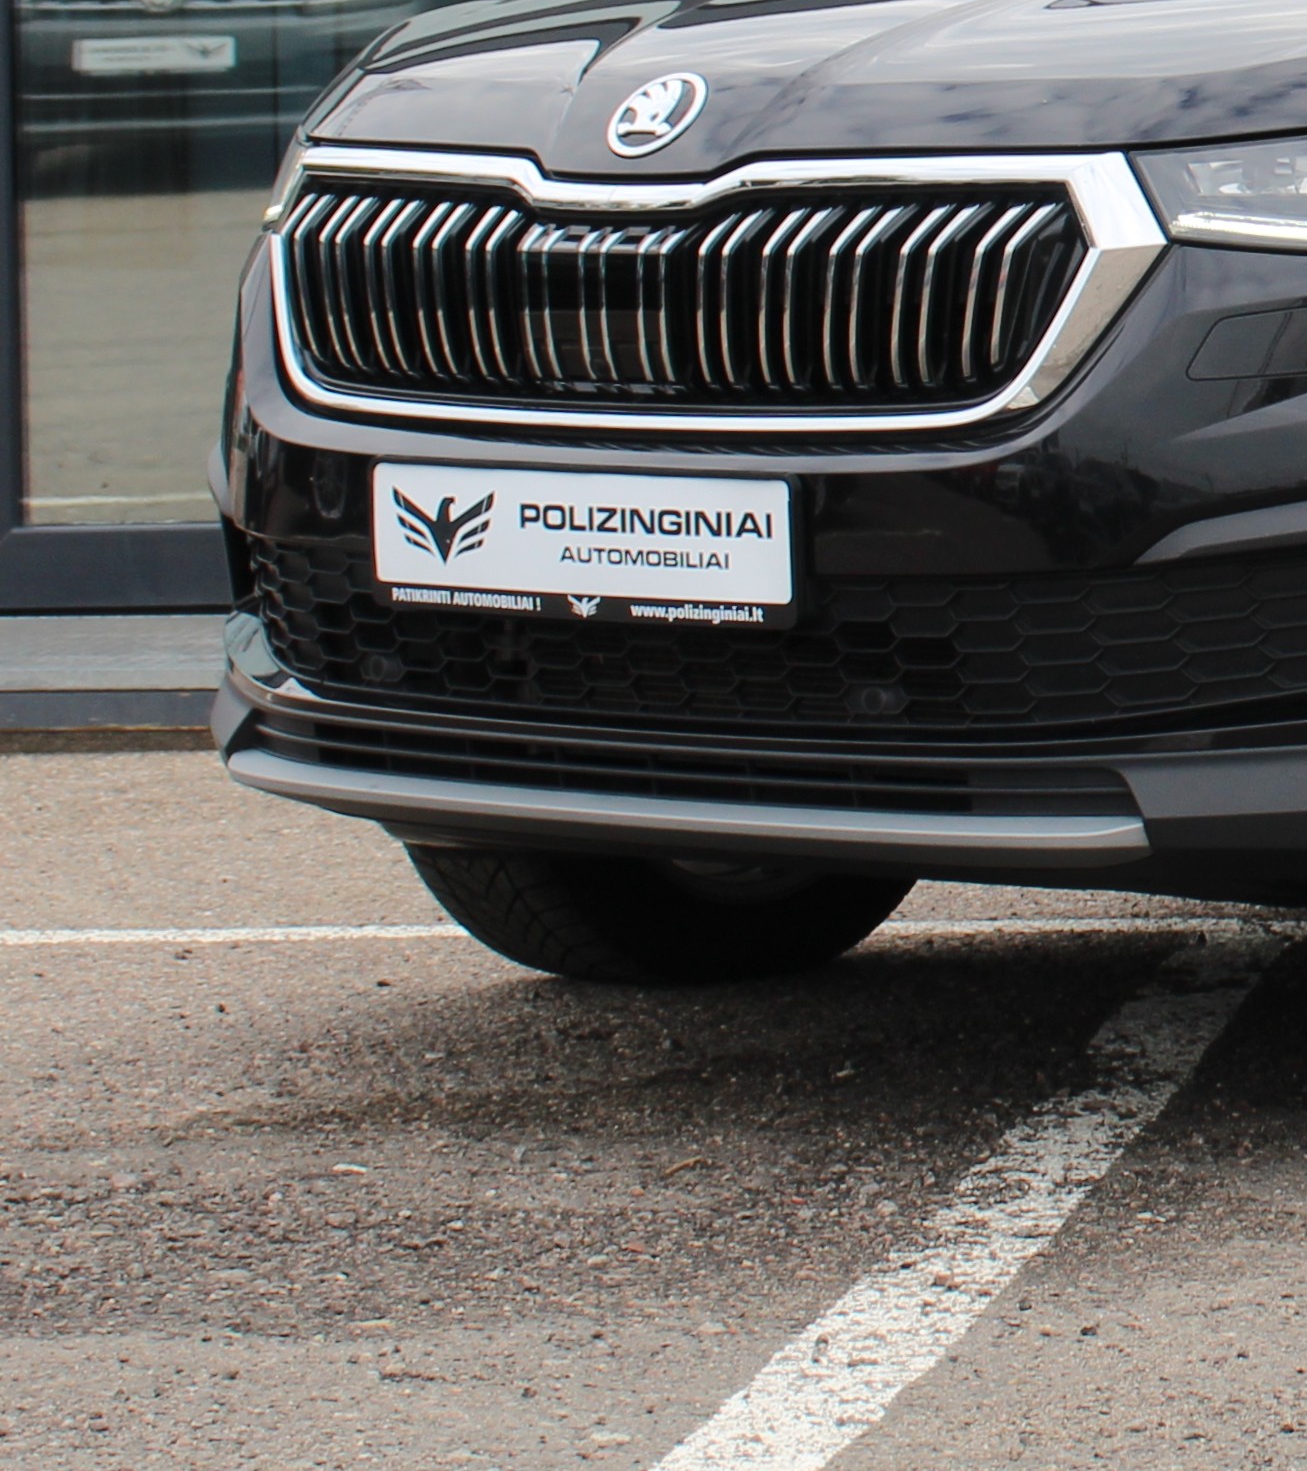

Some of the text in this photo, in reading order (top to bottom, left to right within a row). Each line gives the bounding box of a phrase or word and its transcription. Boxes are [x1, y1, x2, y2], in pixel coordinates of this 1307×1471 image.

[519, 502, 773, 540] POLIZINGINIAI
[560, 546, 730, 570] AUTOMOBILIAI
[391, 587, 451, 605] PATIKRINTI
[452, 591, 534, 611] AUTOMOBILIAI
[630, 603, 764, 624] www.polizinginiai.lt
